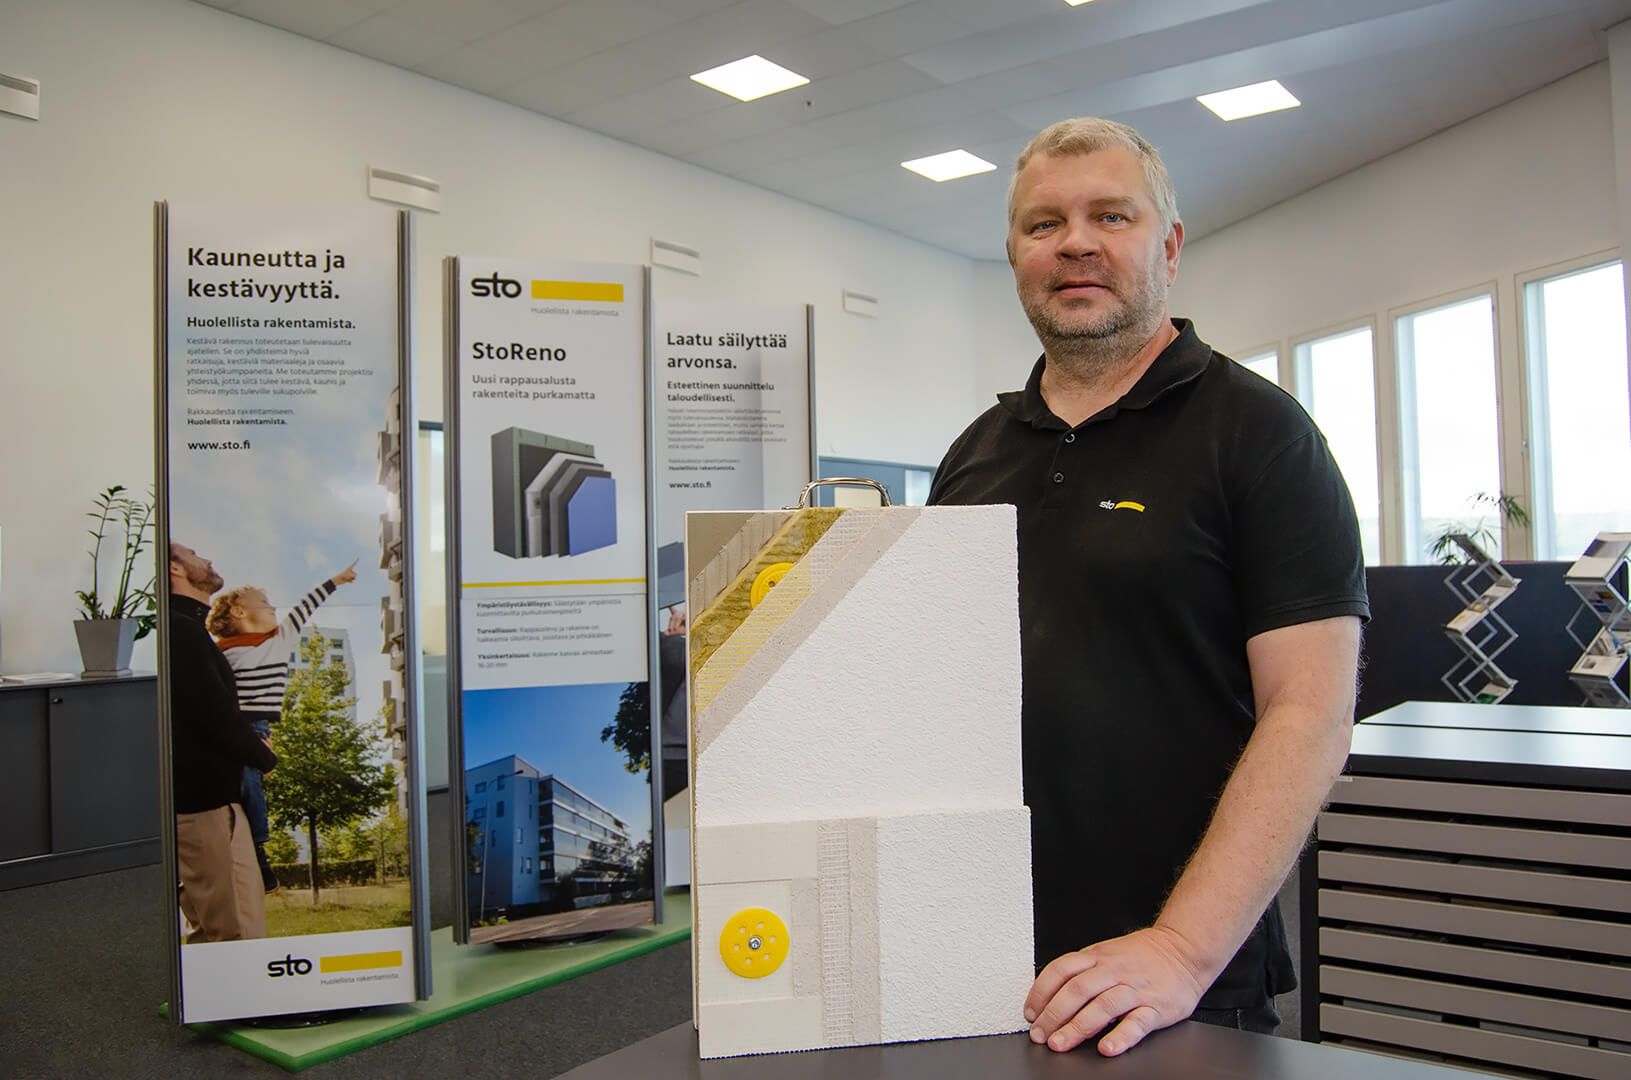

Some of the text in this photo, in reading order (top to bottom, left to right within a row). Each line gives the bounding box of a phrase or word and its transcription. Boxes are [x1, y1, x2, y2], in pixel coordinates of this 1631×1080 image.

[188, 248, 345, 273] Kauneutta ja
[471, 272, 522, 298] sto
[188, 279, 340, 303] kestävyyttä.
[187, 317, 355, 328] Huolellista rakentamista.
[667, 332, 786, 350] Laatu säilyttää
[472, 342, 567, 361] StoReno
[667, 357, 736, 369] arvonsa.
[472, 375, 576, 386] Uusi rappausalusta
[667, 381, 774, 391] Esteettinen suunnittelu
[472, 389, 595, 400] rakenteita purkamatta
[667, 394, 735, 402] taloudellisesti.
[188, 440, 250, 449] www.sto.fi
[1099, 500, 1115, 510] sto
[268, 954, 312, 977] sto
